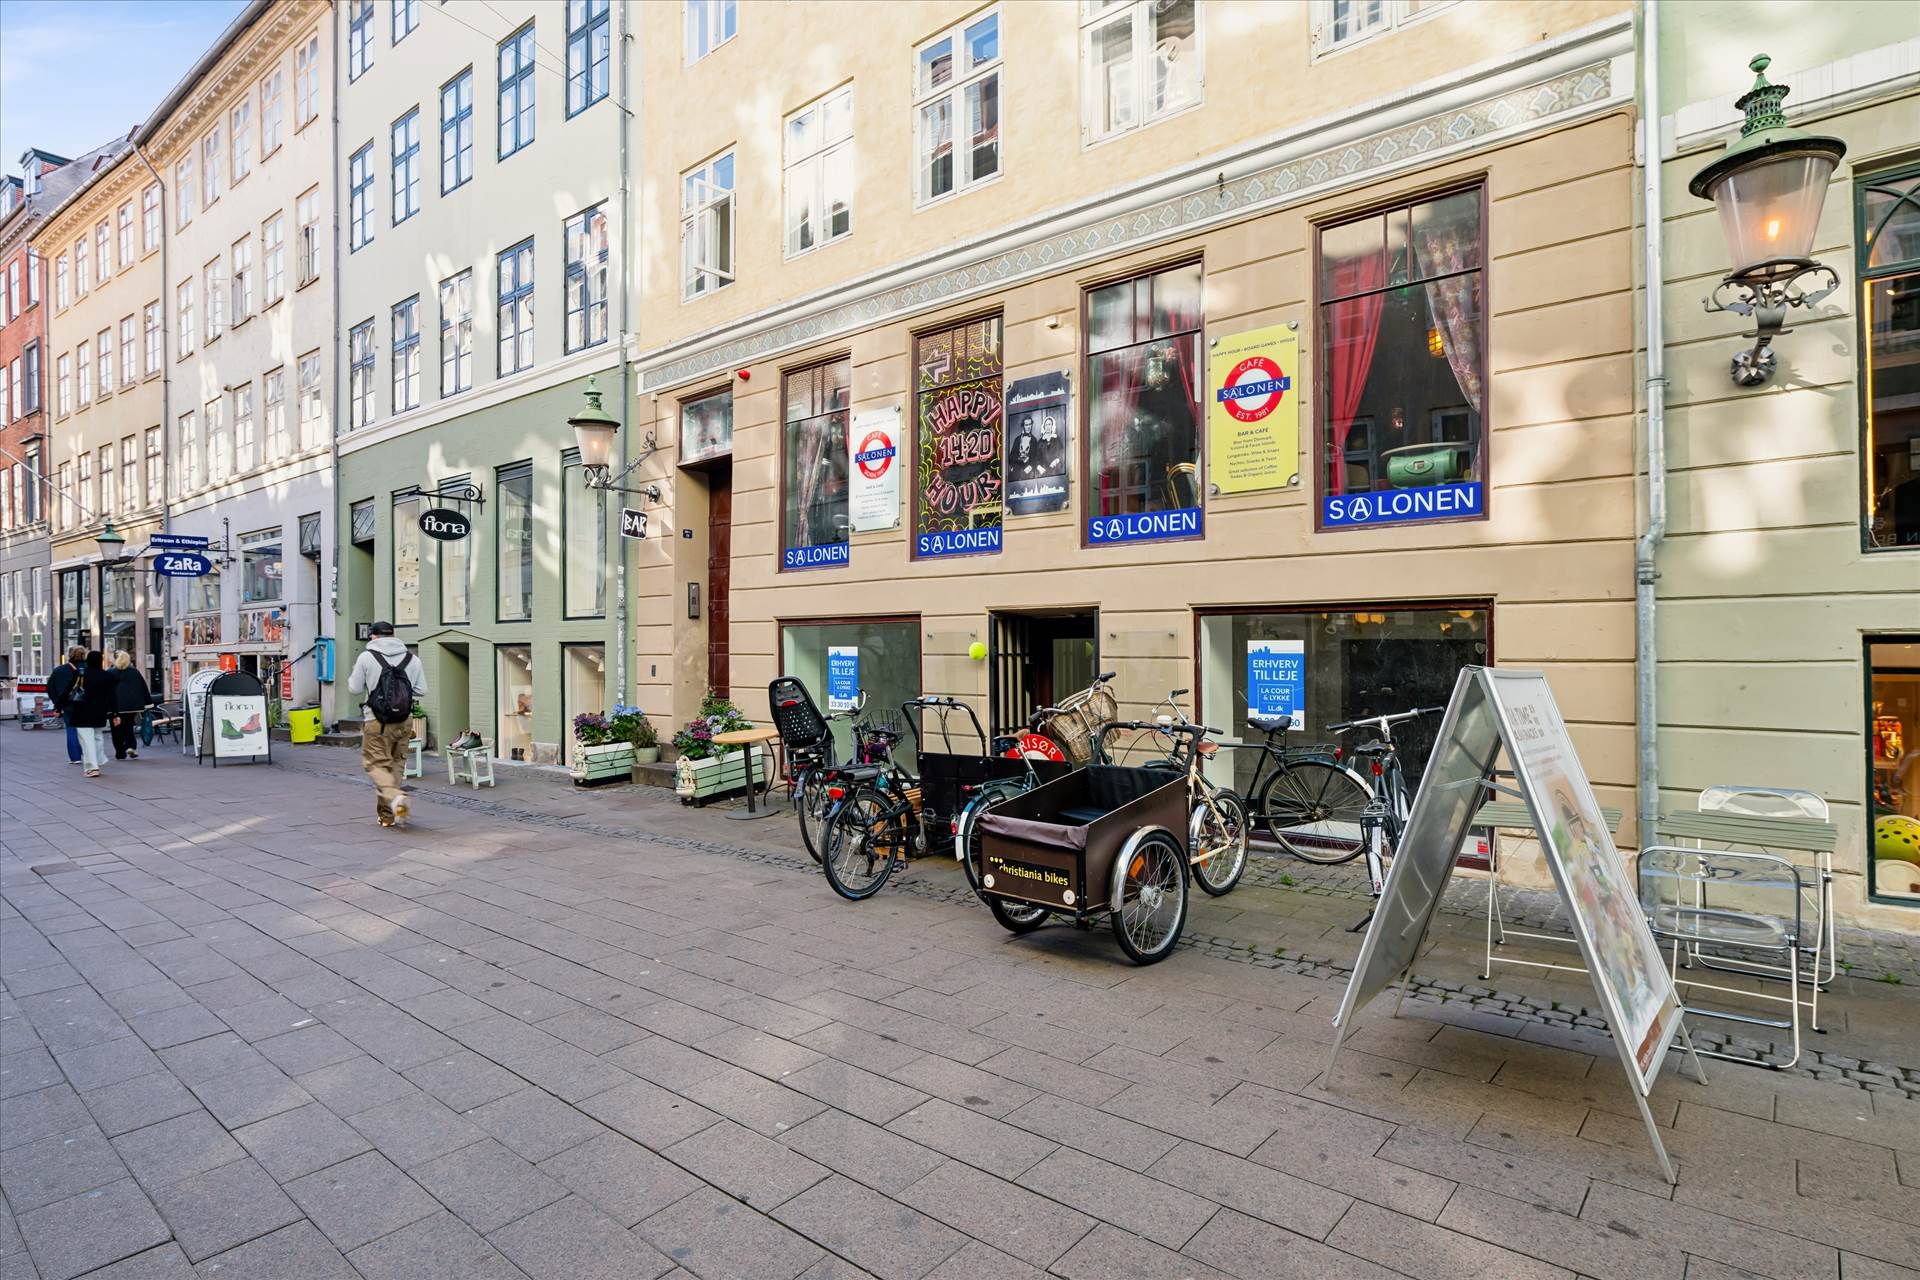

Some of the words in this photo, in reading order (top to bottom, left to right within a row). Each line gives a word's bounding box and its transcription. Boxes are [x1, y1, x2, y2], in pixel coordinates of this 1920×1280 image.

[1223, 380, 1284, 399] SALONEN
[926, 389, 1001, 434] HAPPY
[858, 448, 893, 461] SALONEN
[926, 470, 1001, 514] HOUR
[1329, 487, 1474, 521] SALONEN
[424, 515, 466, 534] fiona
[624, 514, 647, 534] BAR
[1092, 511, 1196, 539] SALONEN
[920, 530, 999, 553] SALONEN
[164, 556, 202, 571] ZaRa
[787, 545, 847, 566] SALONEN
[832, 667, 841, 675] TIL
[841, 667, 855, 675] LEJE
[1252, 659, 1299, 668] ERHVERV
[1253, 670, 1270, 680] TIL
[1272, 670, 1298, 680] LEJE
[1044, 871, 1069, 885] bikes
